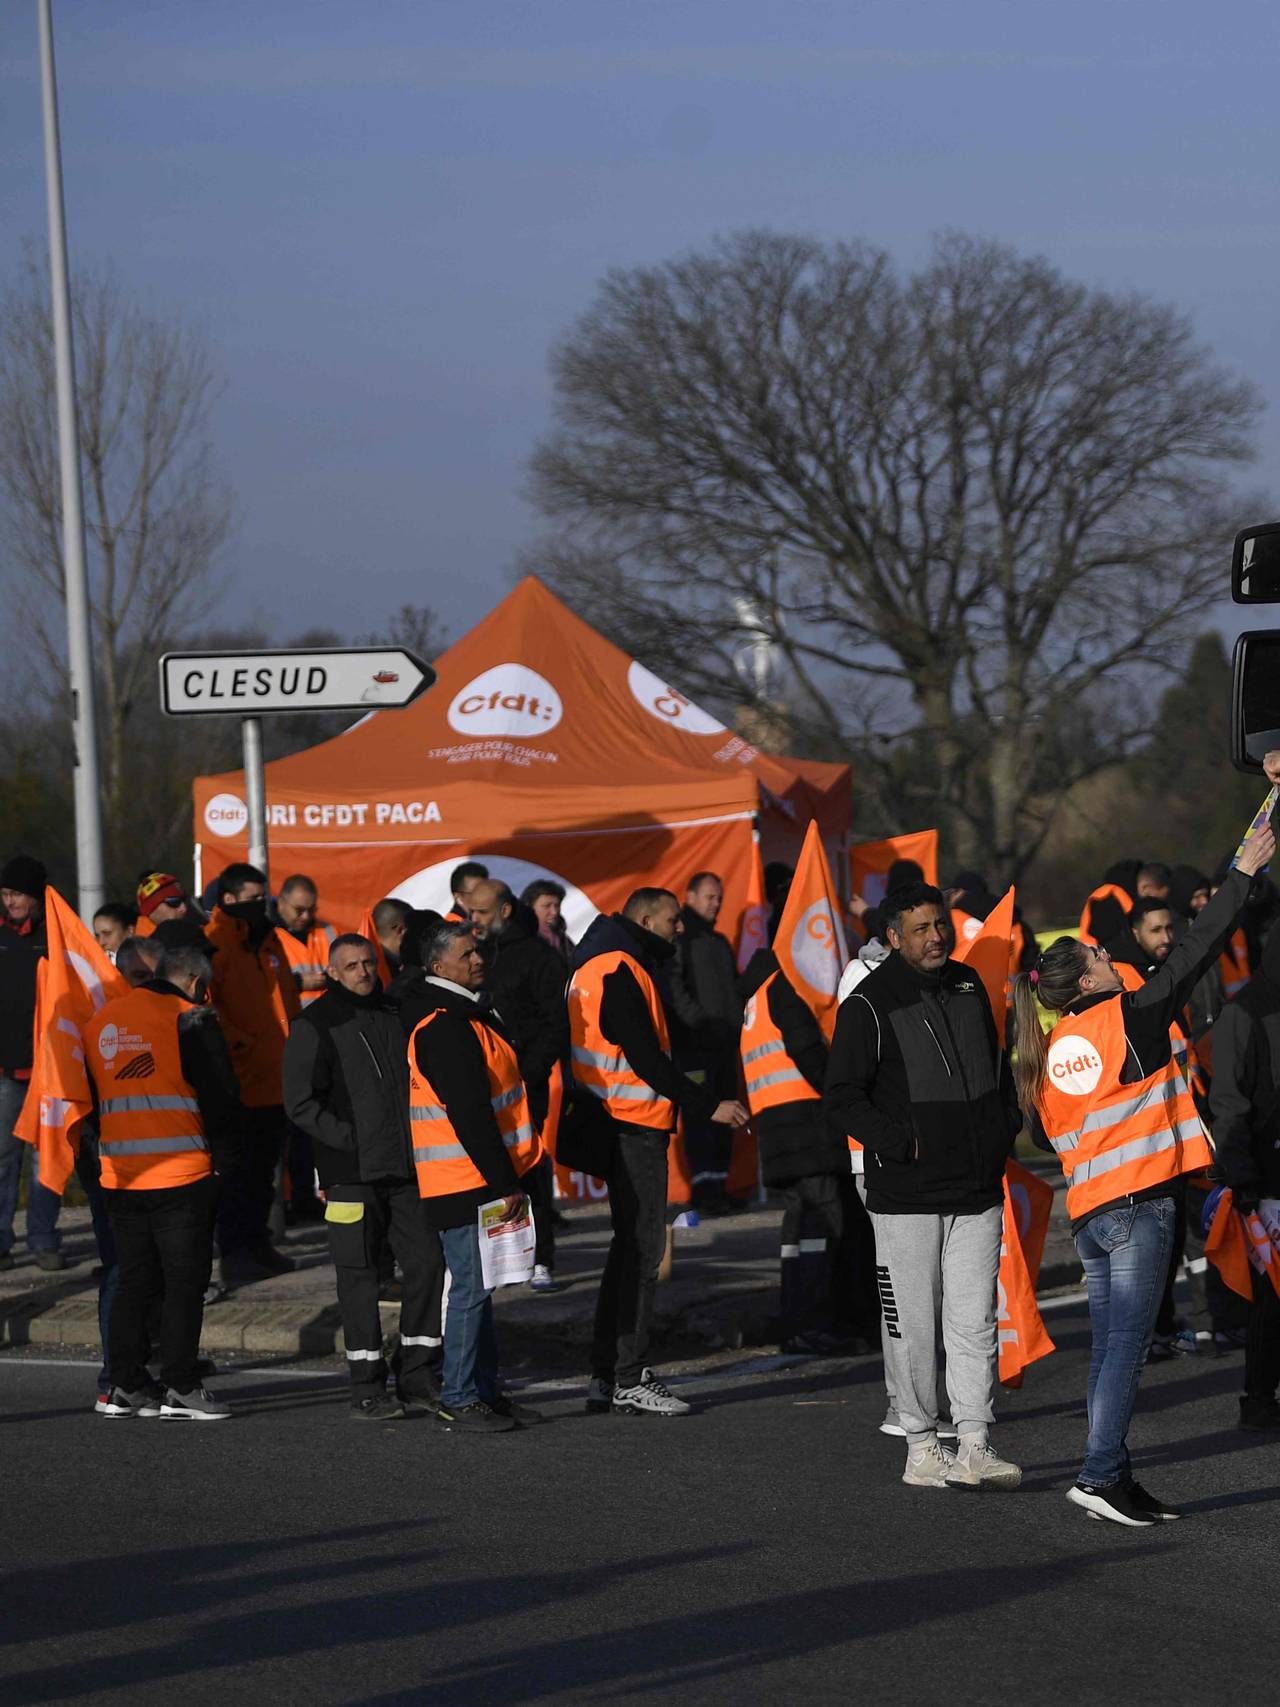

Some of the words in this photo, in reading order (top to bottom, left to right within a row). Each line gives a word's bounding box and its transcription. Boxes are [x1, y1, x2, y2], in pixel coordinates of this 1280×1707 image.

[184, 666, 327, 698] CLESUD
[265, 804, 297, 827] RI
[303, 804, 369, 827] CFDT
[375, 801, 442, 825] PACA
[1052, 1054, 1099, 1078] Cfdt:
[877, 1265, 902, 1339] PUMA
